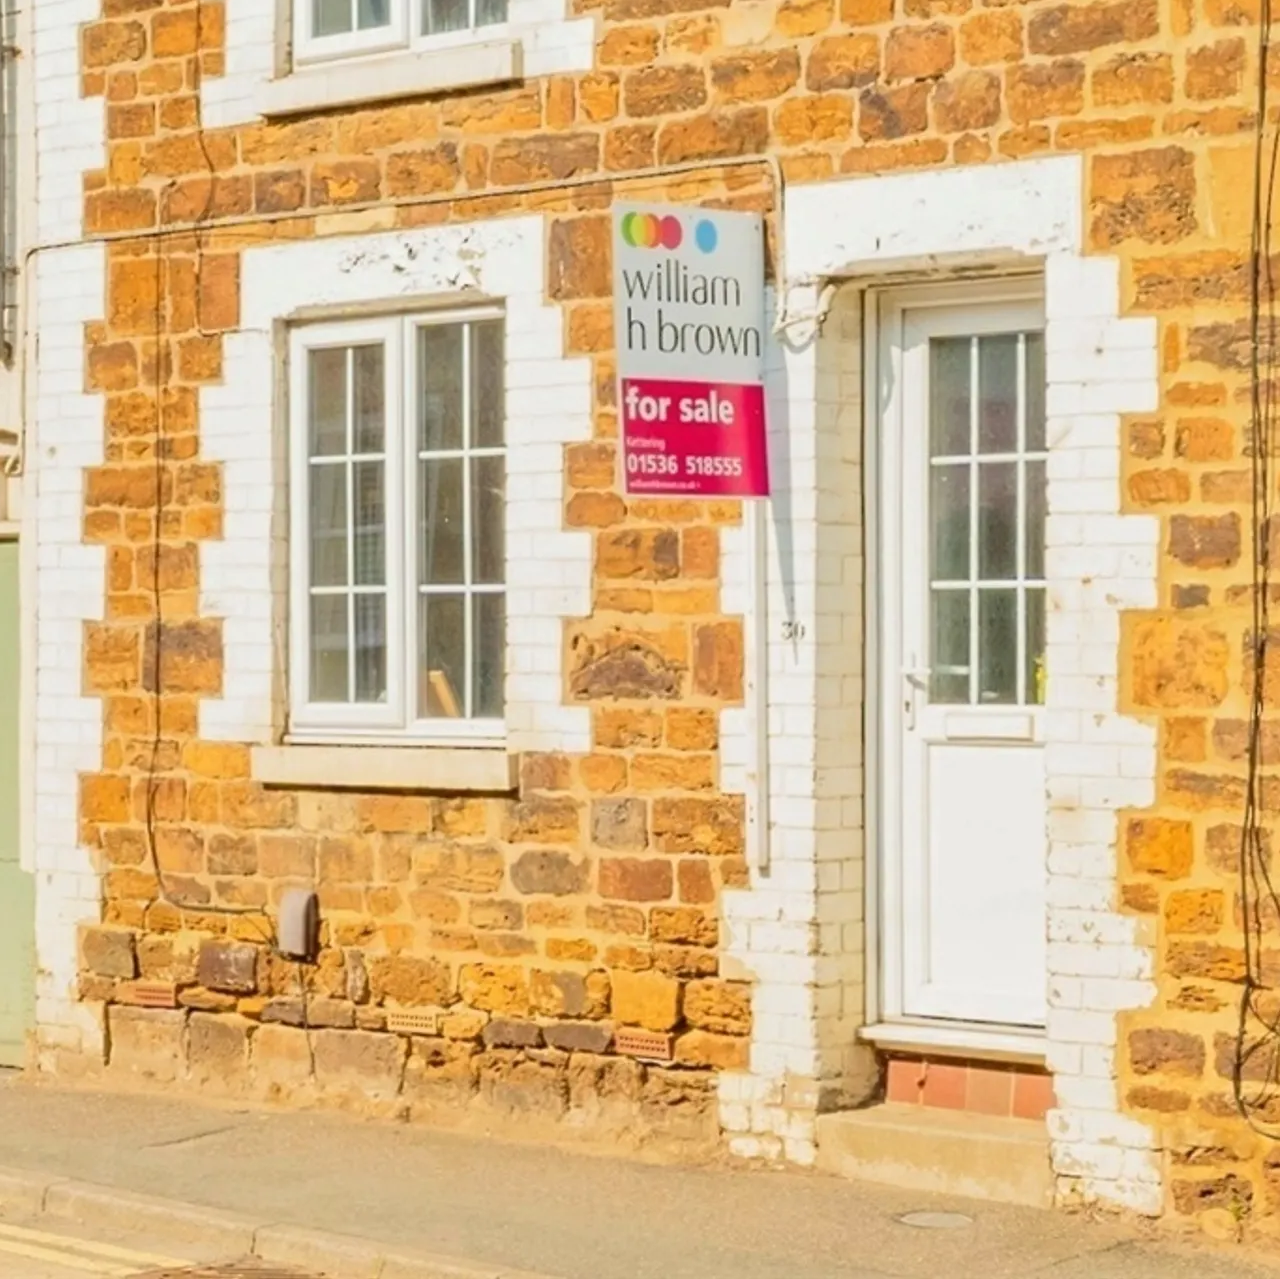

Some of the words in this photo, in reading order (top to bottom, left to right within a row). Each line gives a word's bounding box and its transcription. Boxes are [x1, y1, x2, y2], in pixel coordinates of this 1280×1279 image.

[623, 258, 741, 306] william
[627, 306, 646, 350] h
[658, 308, 761, 357] brown
[625, 386, 671, 421] for
[679, 389, 735, 425] sale
[627, 453, 679, 475] 01536
[685, 455, 743, 477] 518555
